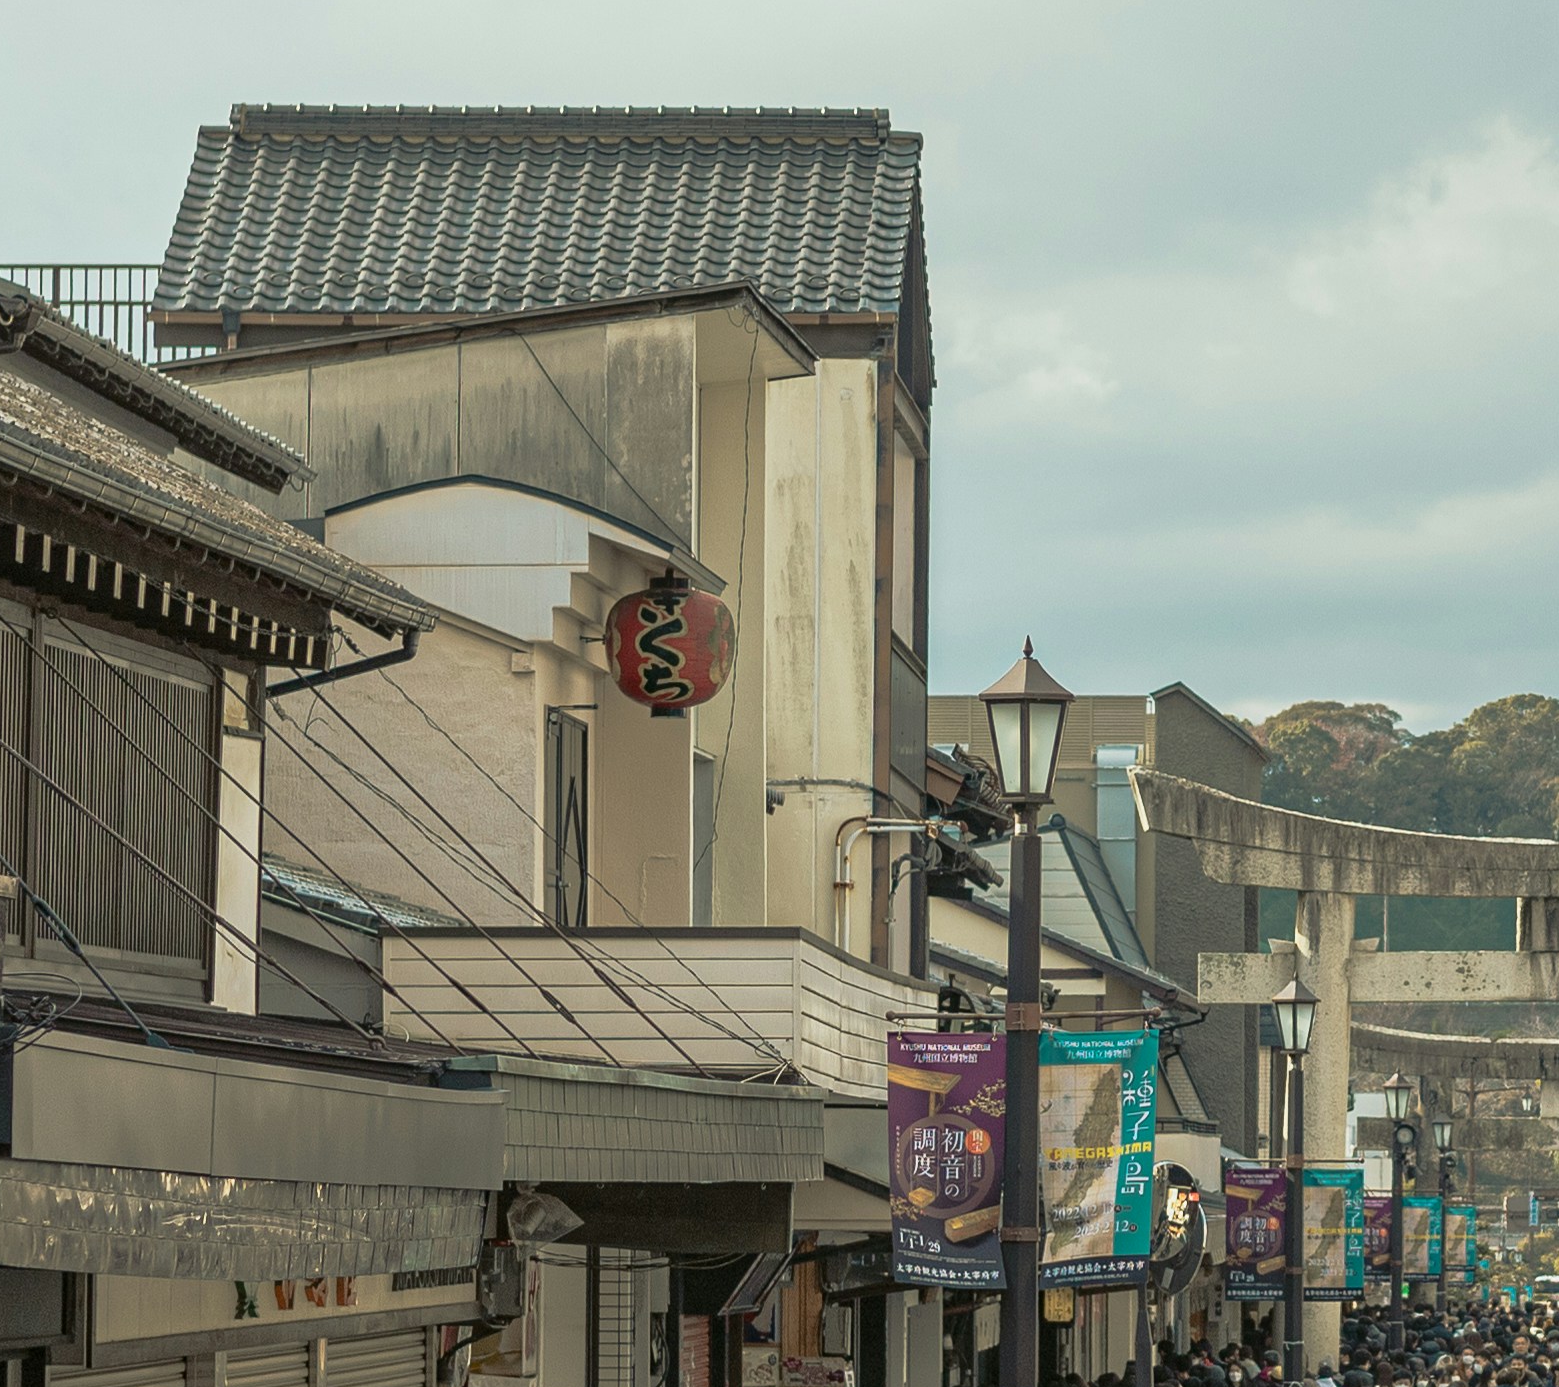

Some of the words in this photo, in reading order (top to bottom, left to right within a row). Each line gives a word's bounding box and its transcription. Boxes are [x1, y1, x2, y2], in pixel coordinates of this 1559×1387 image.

[928, 1043, 961, 1052] NATIONAL
[913, 1128, 937, 1178] 調度
[940, 1128, 965, 1198] 初音の
